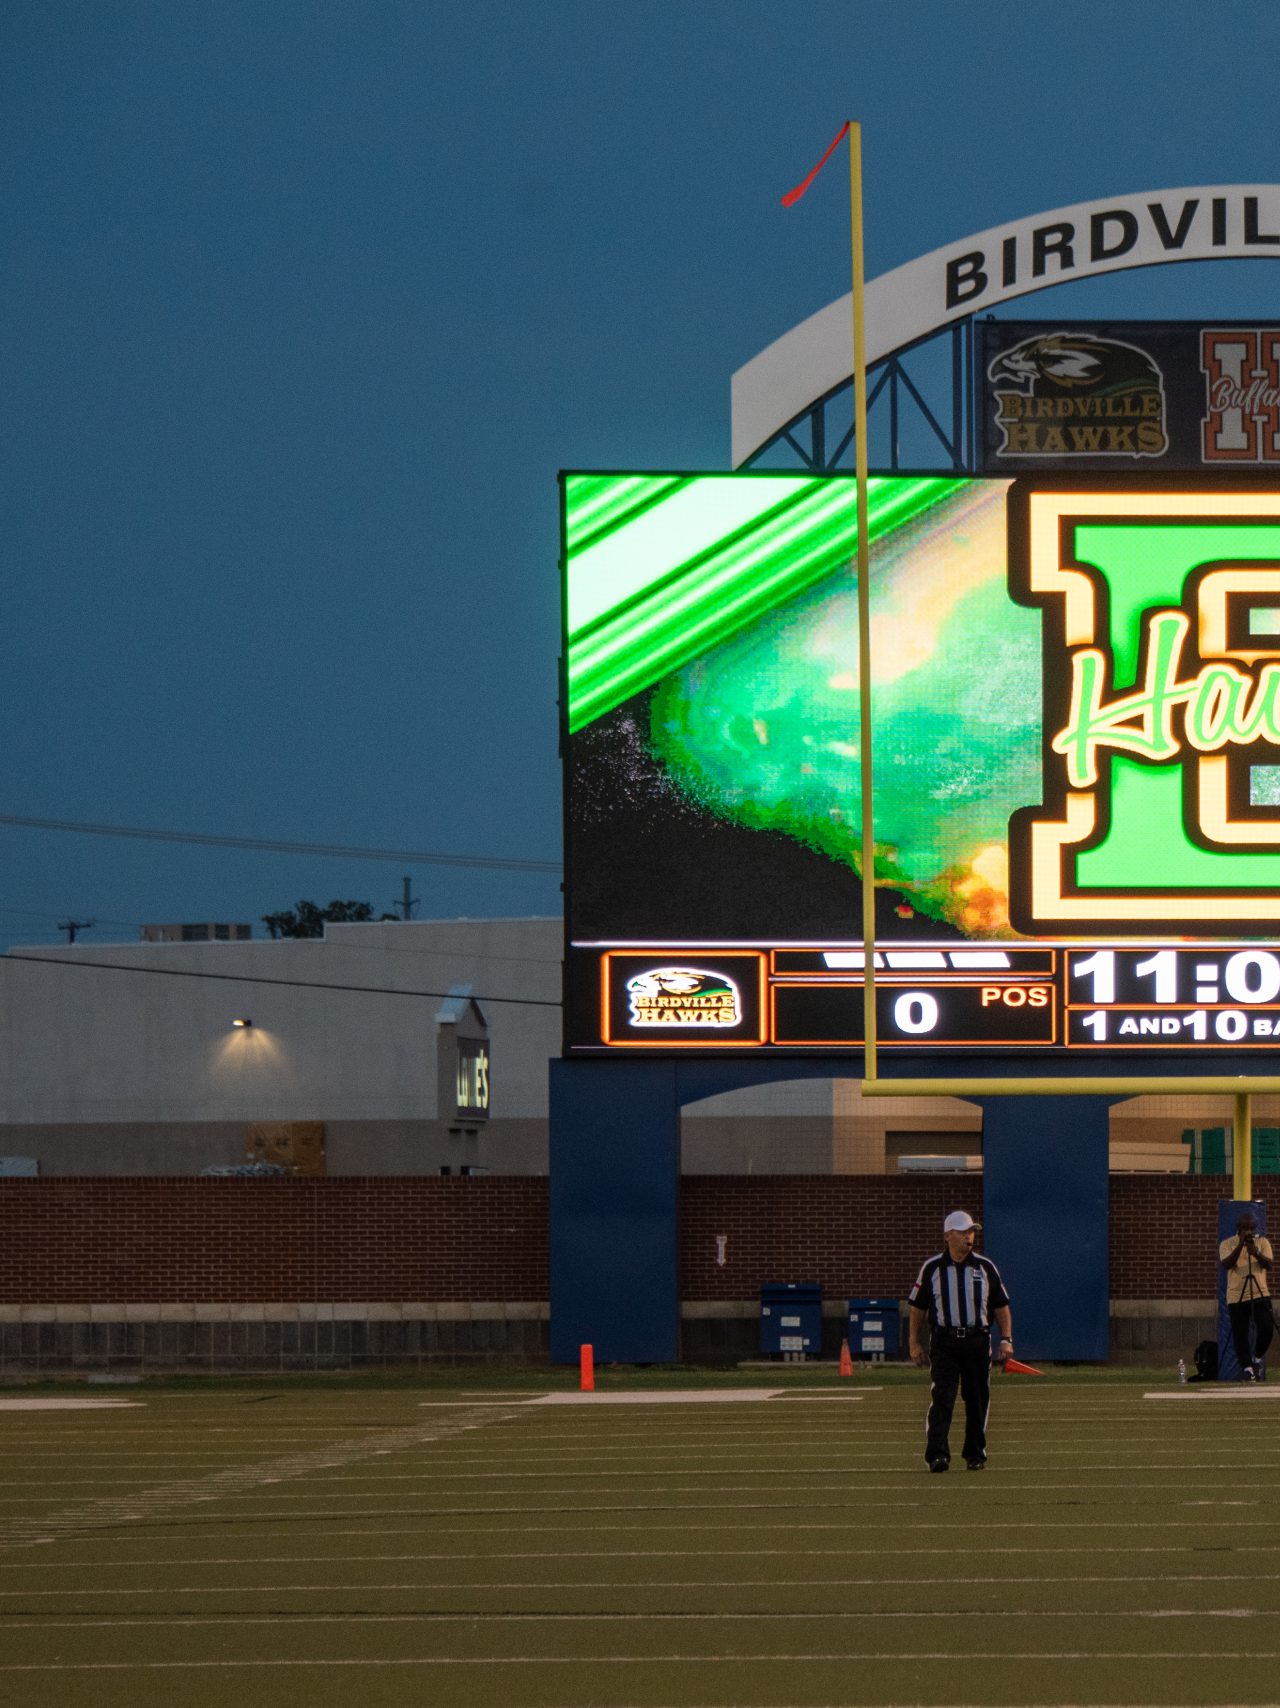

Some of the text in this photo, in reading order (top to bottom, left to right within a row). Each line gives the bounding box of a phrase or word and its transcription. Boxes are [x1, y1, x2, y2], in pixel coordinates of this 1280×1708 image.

[1000, 393, 1162, 418] BIRDVILLE
[1003, 419, 1166, 454] HAWKS
[637, 994, 735, 1008] BIRDVILLE
[981, 986, 1049, 1008] POS
[638, 1007, 737, 1023] HAWKS
[893, 991, 939, 1035] 0
[1082, 1009, 1107, 1042] 1
[1118, 1017, 1182, 1035] AND
[1182, 1009, 1248, 1042] 10
